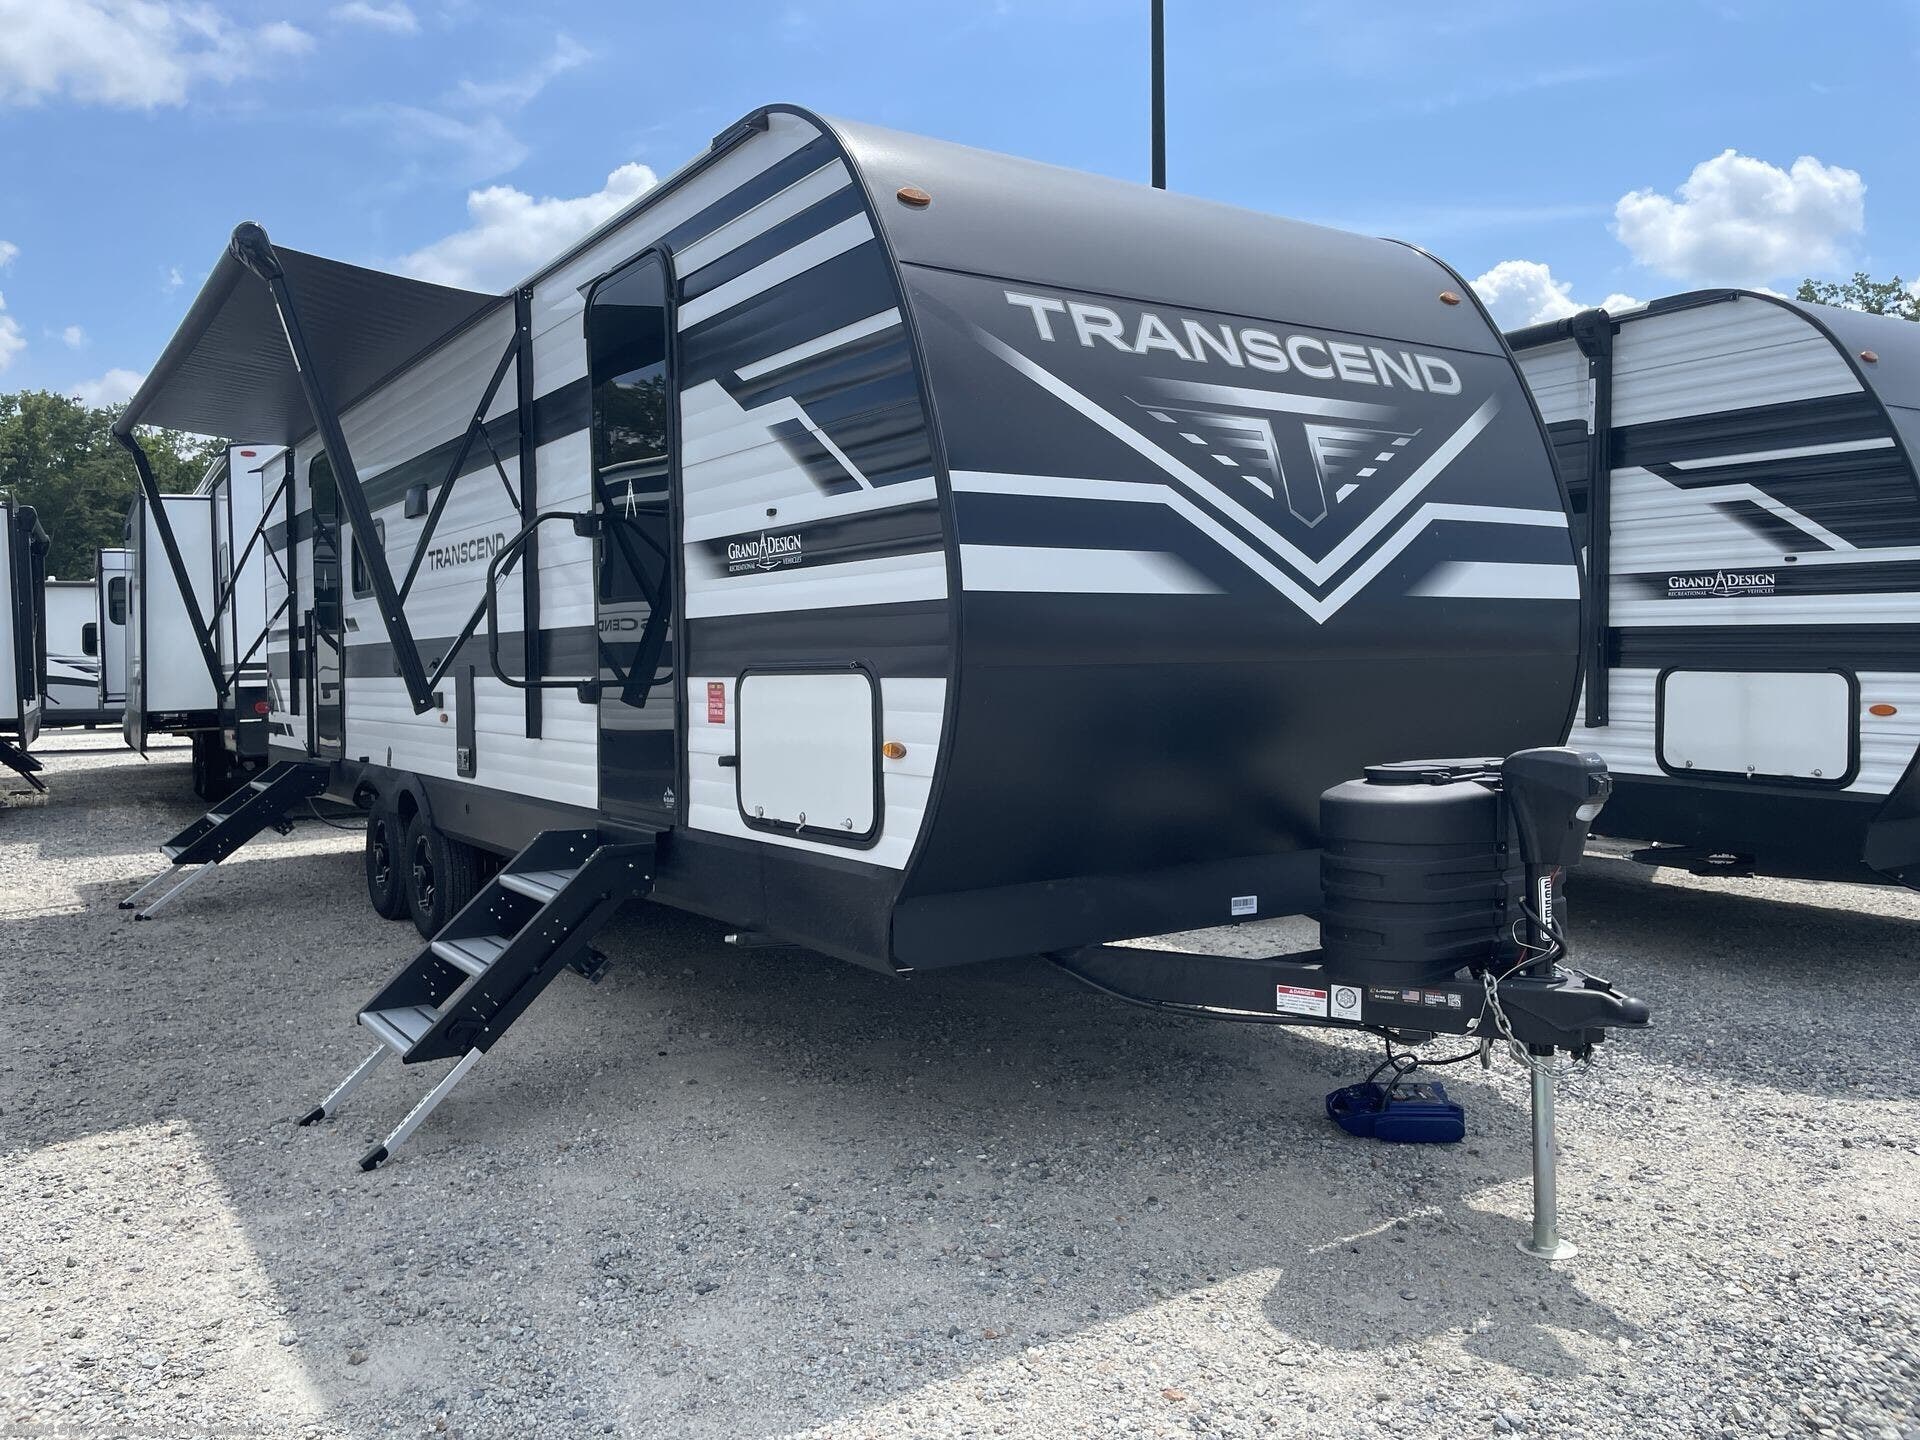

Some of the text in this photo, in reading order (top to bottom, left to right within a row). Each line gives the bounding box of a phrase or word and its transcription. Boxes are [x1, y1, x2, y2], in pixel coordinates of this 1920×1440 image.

[1003, 290, 1462, 395] TRANSCEND
[428, 532, 506, 570] TRANSCEND
[728, 534, 802, 559] GRAND DESIGN
[1668, 574, 1775, 588] GRAND DESIGN
